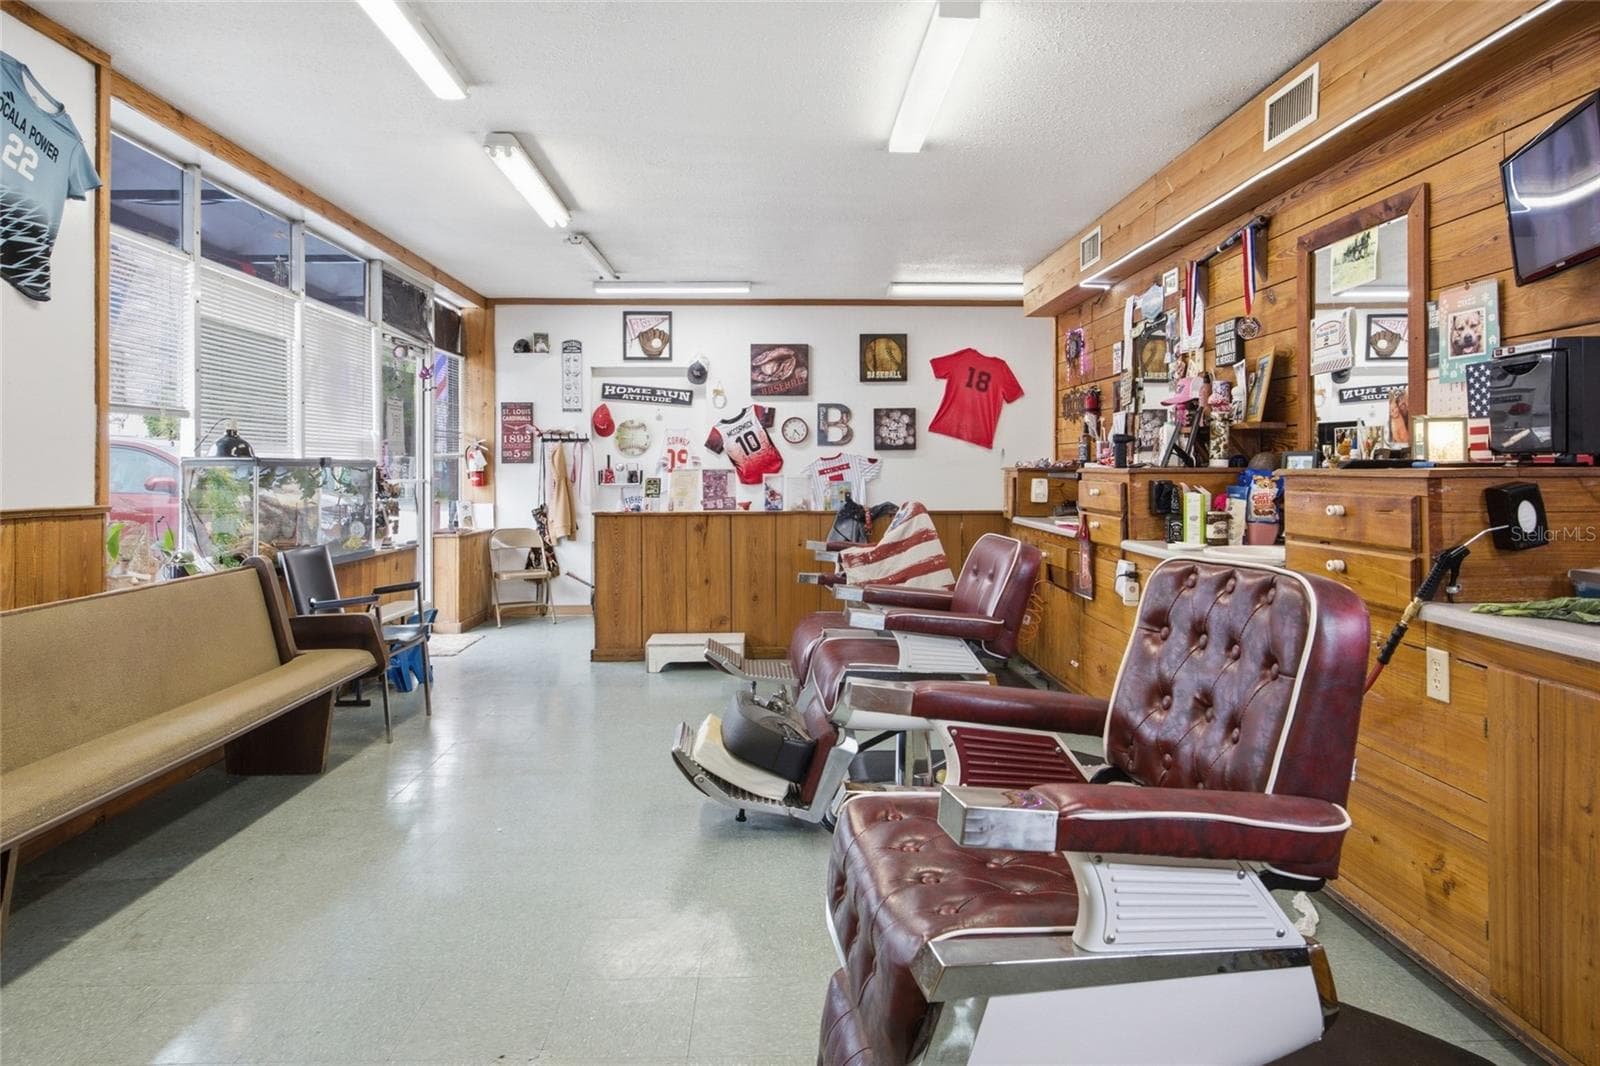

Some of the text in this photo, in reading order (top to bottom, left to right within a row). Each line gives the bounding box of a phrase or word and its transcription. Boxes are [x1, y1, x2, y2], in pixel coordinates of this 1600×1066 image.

[2, 133, 39, 182] 22
[29, 125, 60, 164] POWER
[866, 370, 902, 379] BASEBALL
[965, 366, 991, 393] 18
[604, 385, 691, 402] HOME RUN
[622, 393, 673, 403] ATTITUDE
[503, 434, 531, 443] 1892
[817, 403, 854, 447] B
[735, 430, 762, 457] 10
